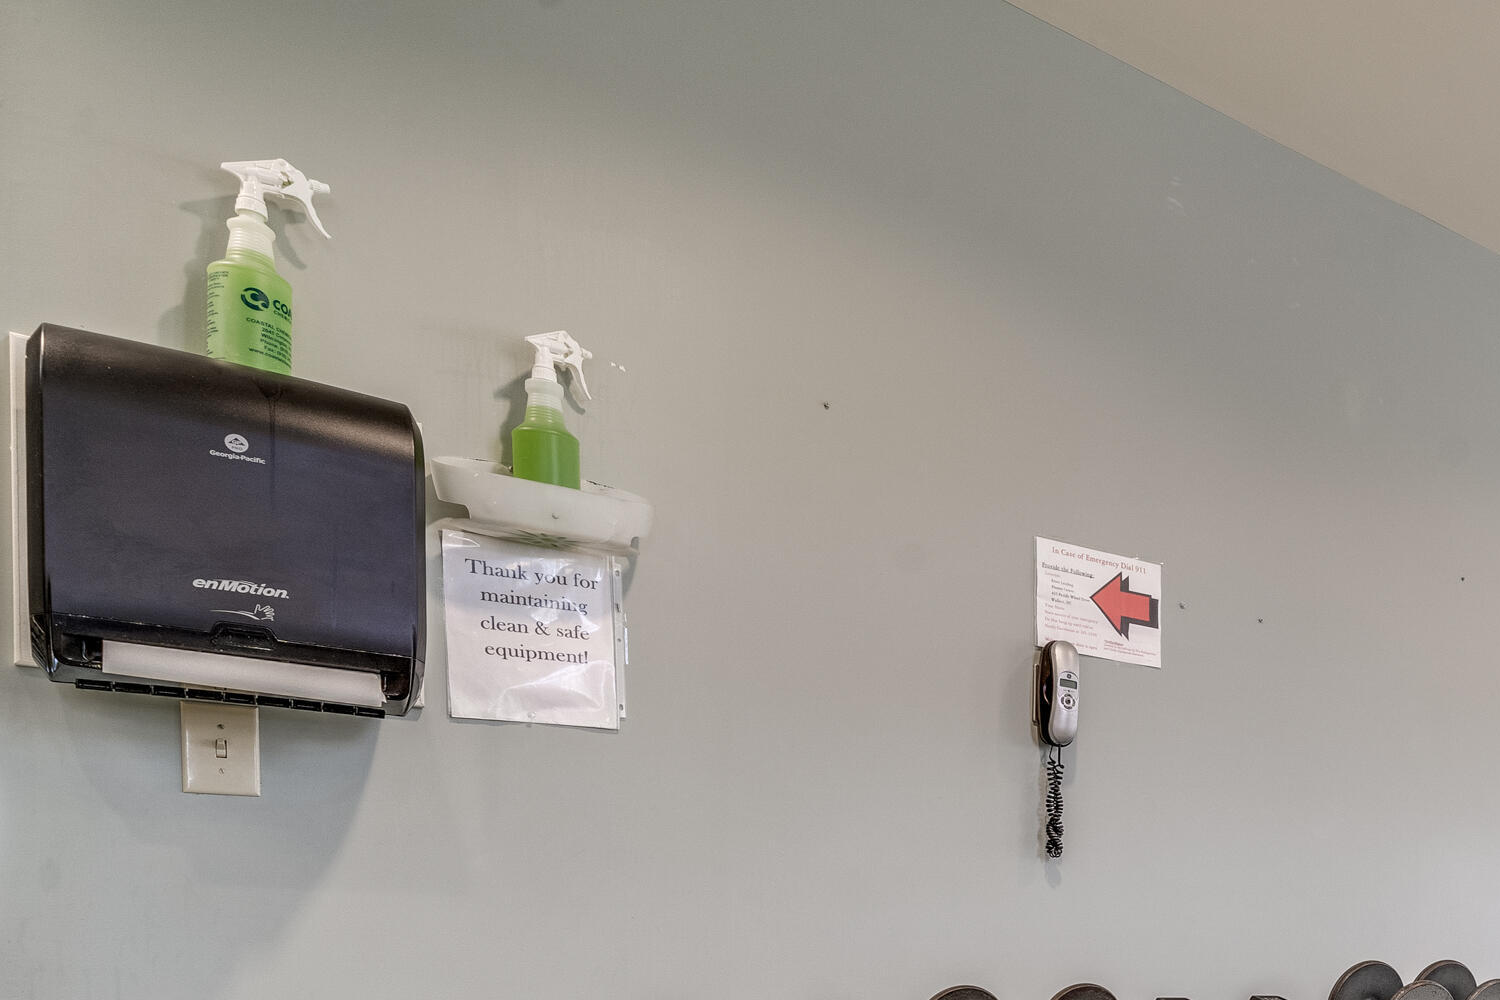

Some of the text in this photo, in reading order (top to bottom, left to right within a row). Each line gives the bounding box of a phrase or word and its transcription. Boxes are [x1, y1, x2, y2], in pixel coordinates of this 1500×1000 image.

[209, 449, 266, 465] Georgia-Pacific
[1052, 546, 1060, 554] In
[1060, 549, 1075, 558] Case
[1085, 554, 1119, 569] Emergency
[1120, 562, 1135, 572] Dial
[1135, 565, 1146, 574] 911
[465, 558, 598, 590] Thank you for
[480, 590, 588, 615] maintaining
[480, 616, 590, 641] clean & safe
[484, 644, 589, 664] equipment!
